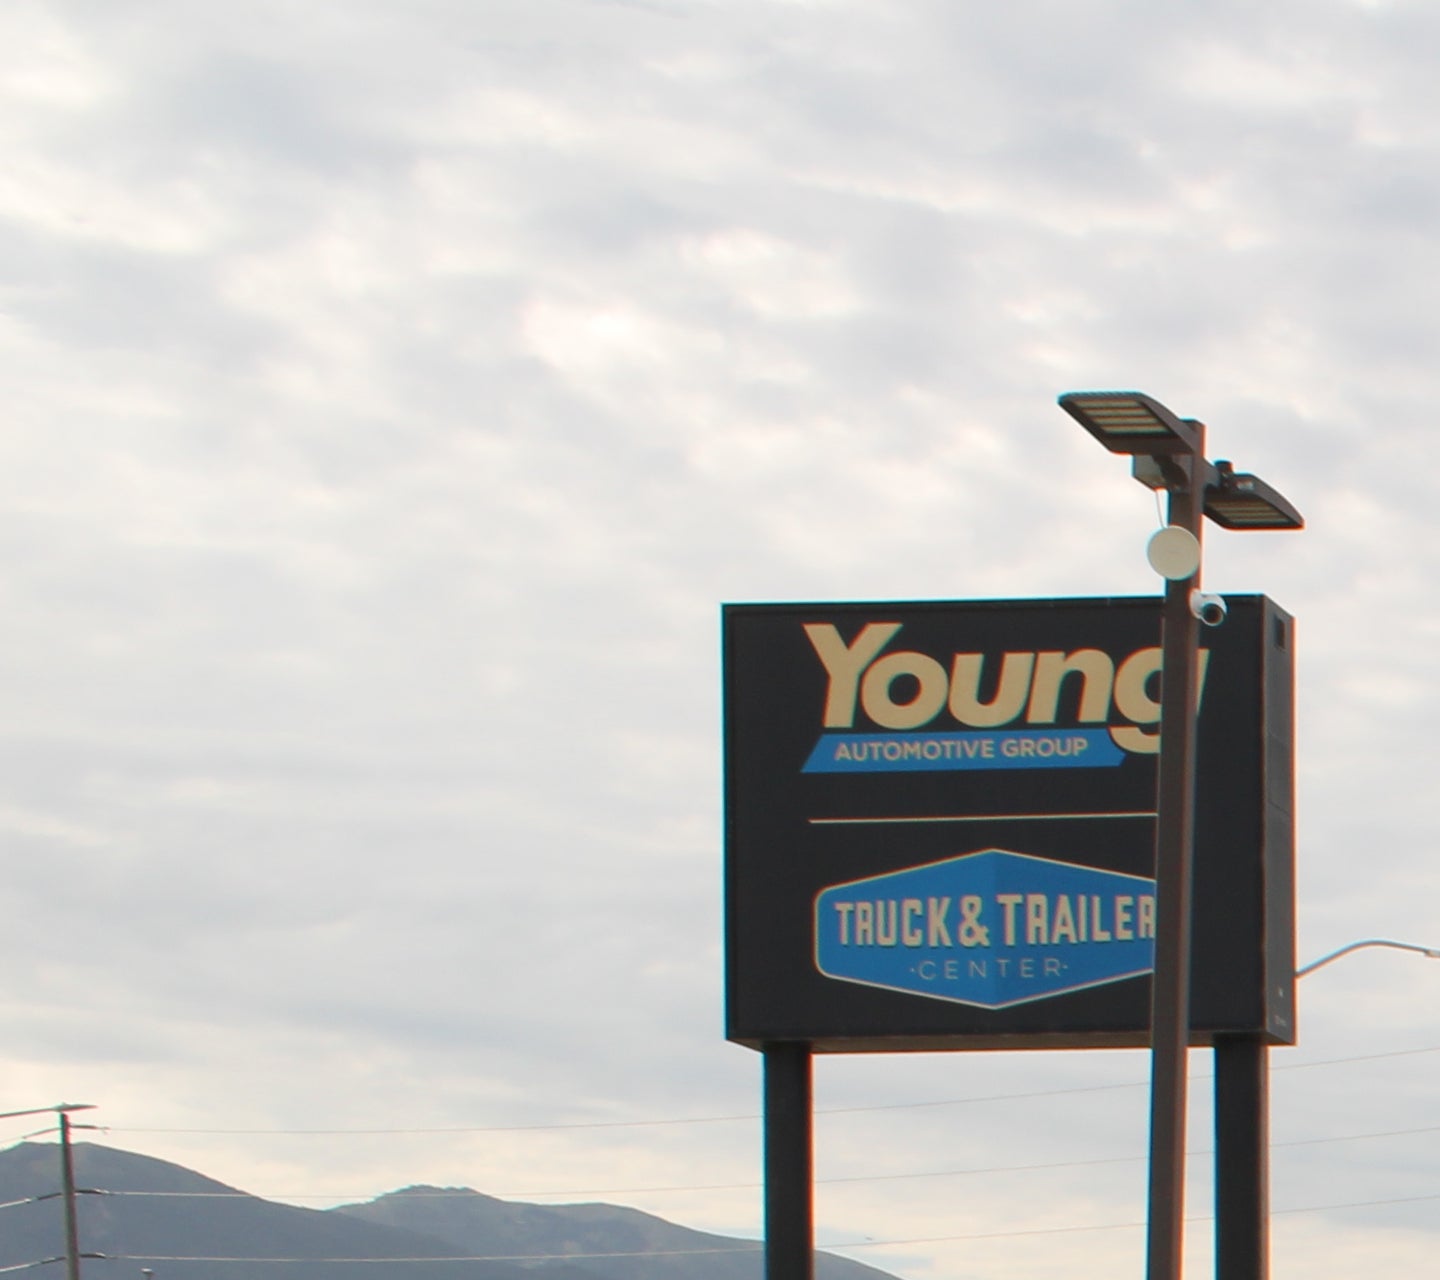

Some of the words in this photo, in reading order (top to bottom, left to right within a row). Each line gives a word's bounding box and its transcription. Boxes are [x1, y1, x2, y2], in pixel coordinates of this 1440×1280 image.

[802, 621, 1209, 755] Young
[834, 738, 995, 762] AUTOMOTIVE
[1001, 737, 1089, 758] GROUP
[834, 897, 952, 947] TRUCK
[957, 894, 991, 948] &
[996, 893, 1157, 946] TRAILER
[918, 957, 1061, 981] CENTER
